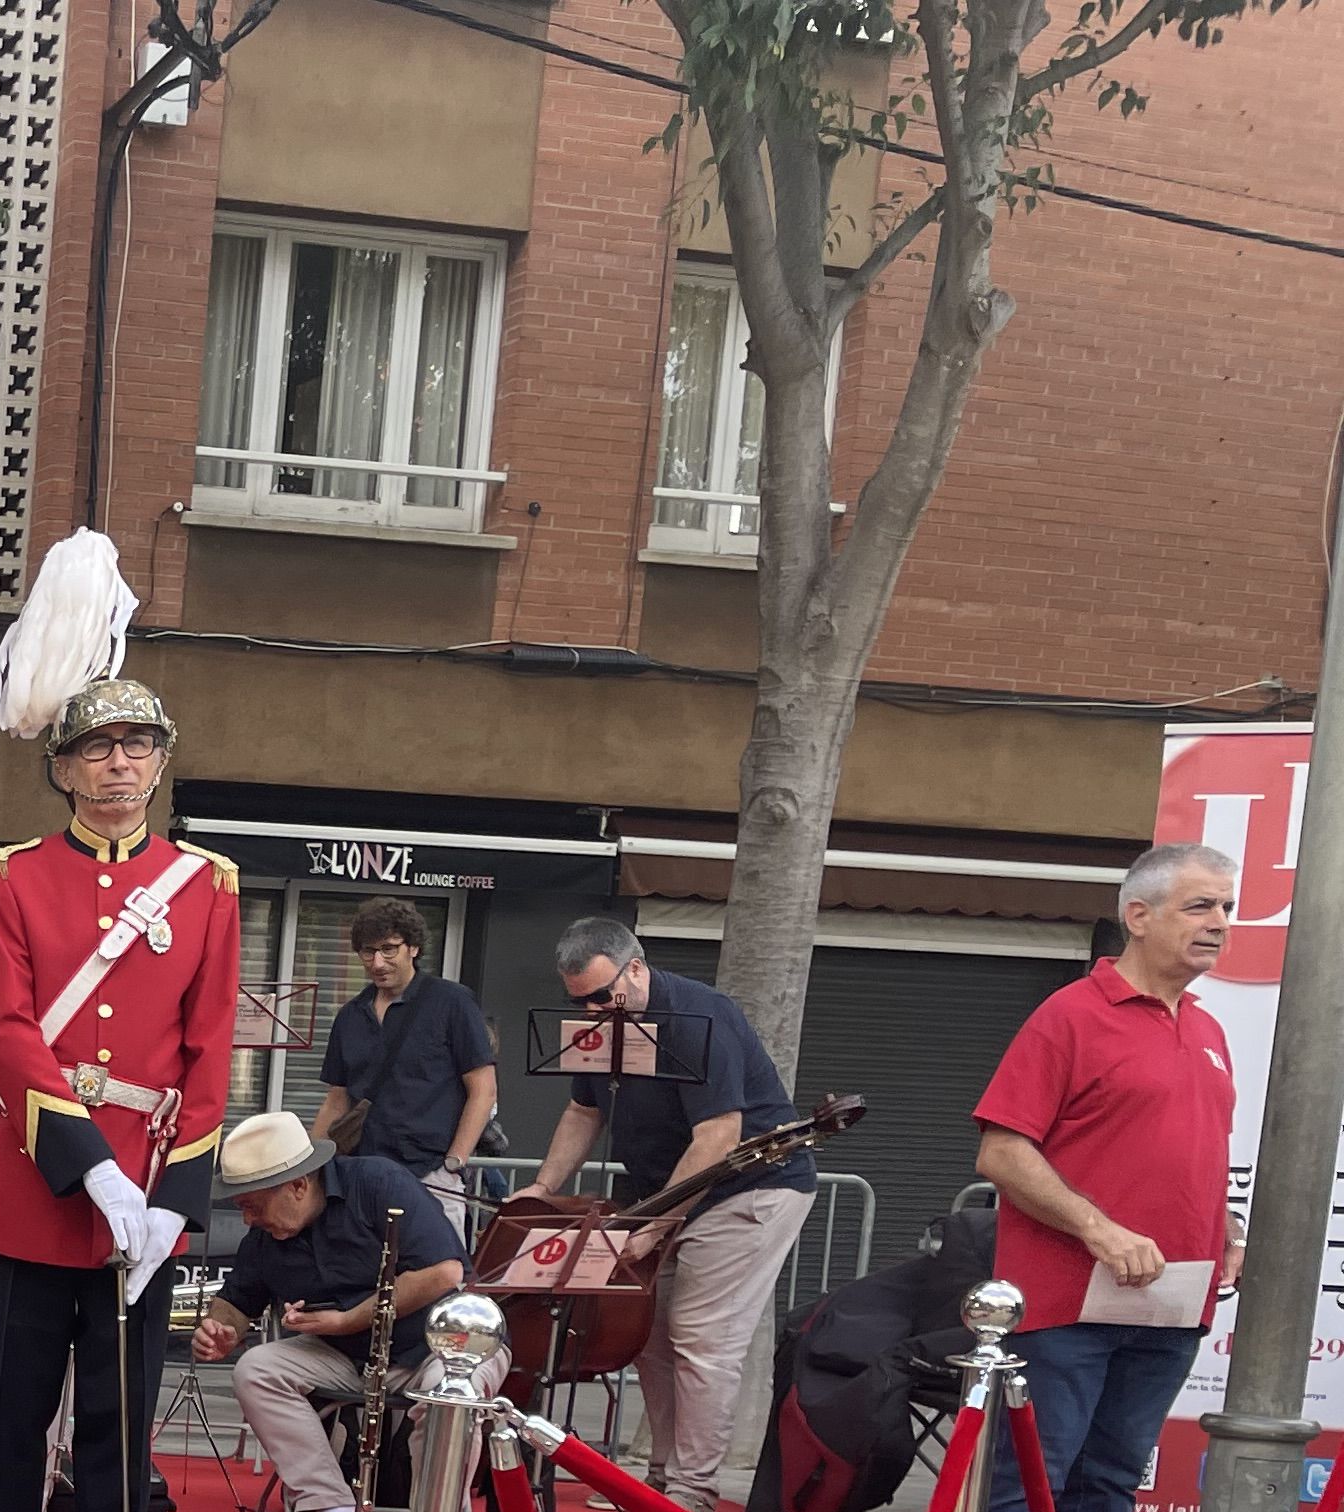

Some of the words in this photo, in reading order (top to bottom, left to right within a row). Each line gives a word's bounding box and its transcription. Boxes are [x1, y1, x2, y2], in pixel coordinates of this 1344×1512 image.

[331, 840, 413, 885] L'ONZE
[414, 872, 455, 888] LOUNGE
[457, 874, 495, 890] COFFEE
